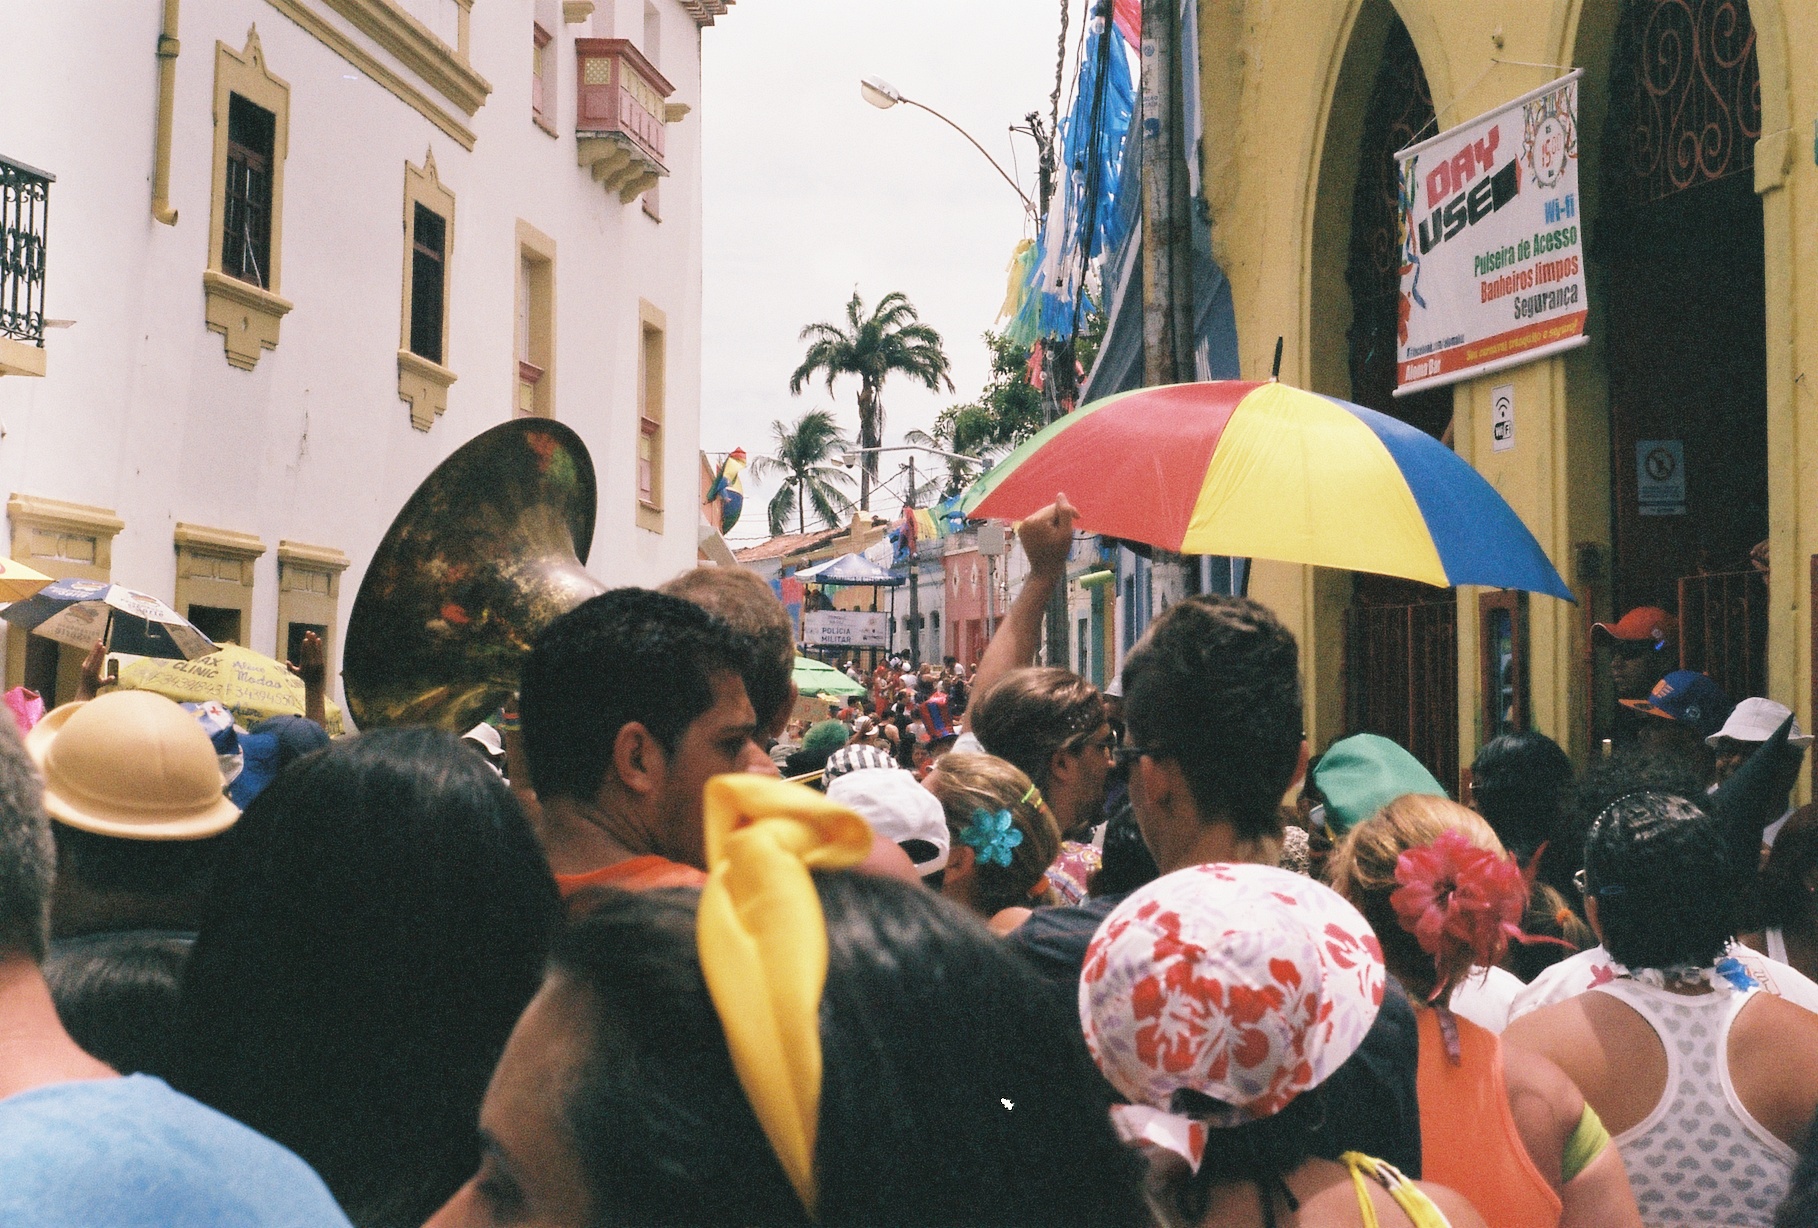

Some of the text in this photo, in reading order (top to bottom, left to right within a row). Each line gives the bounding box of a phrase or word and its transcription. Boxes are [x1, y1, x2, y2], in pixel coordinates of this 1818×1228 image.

[1426, 125, 1499, 209] DAY
[1419, 175, 1493, 255] USE
[1544, 193, 1575, 225] Wi-fi
[1474, 225, 1578, 278] Pulseira de Acesso
[1481, 255, 1579, 304] Banheiros limpos
[1514, 283, 1578, 320] Segurança
[821, 635, 852, 644] MILITAR
[173, 661, 219, 678] CLINIC
